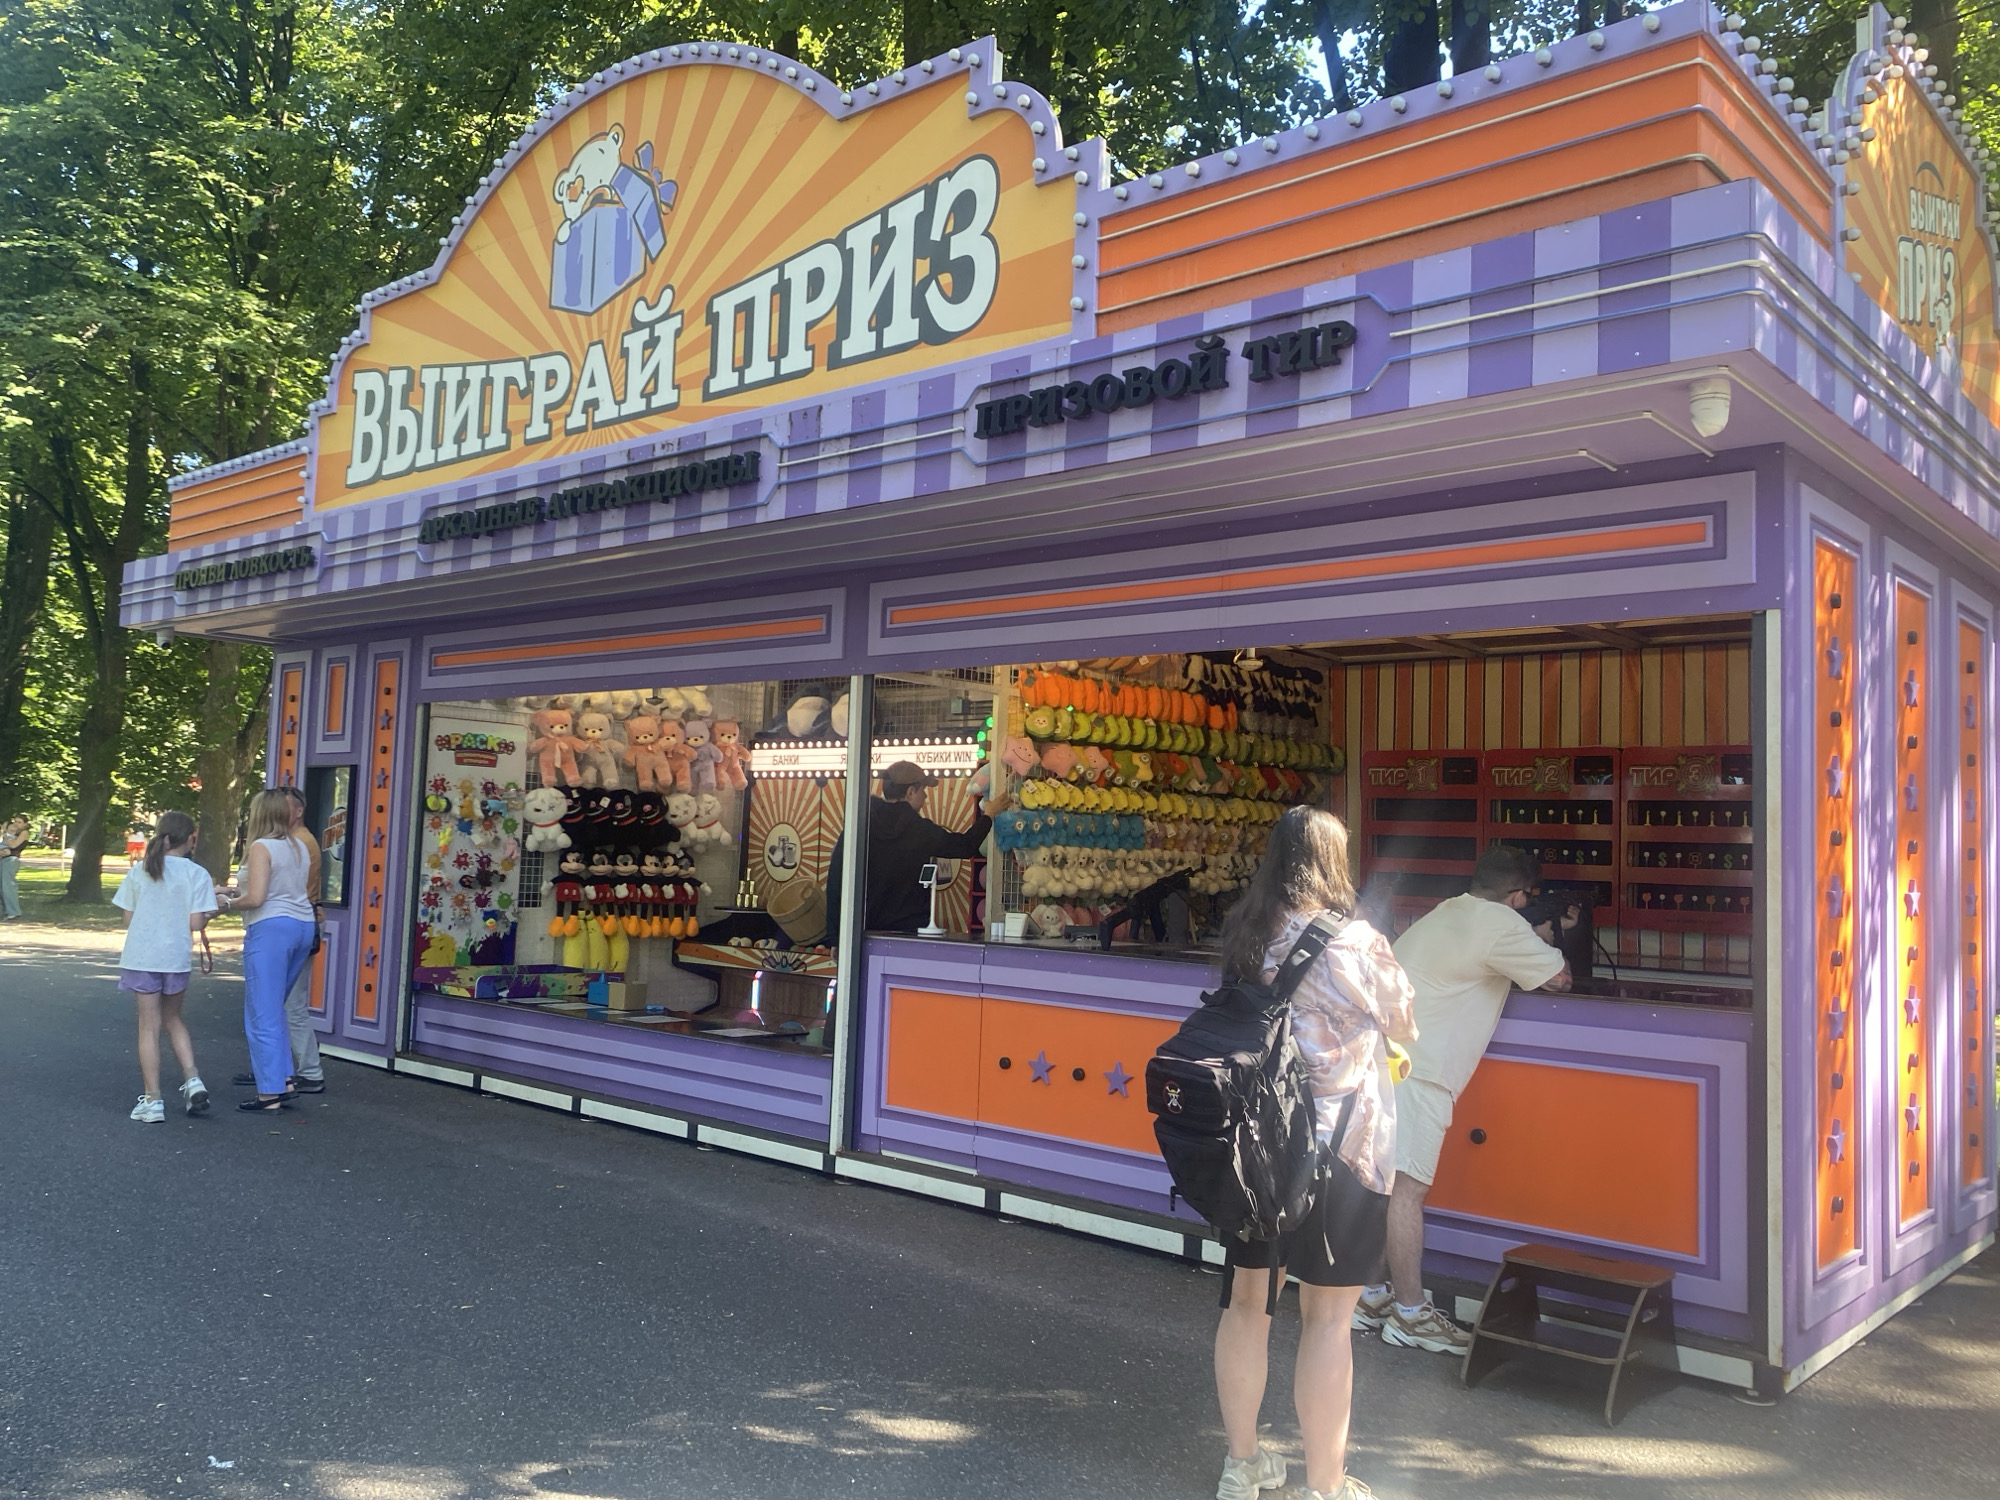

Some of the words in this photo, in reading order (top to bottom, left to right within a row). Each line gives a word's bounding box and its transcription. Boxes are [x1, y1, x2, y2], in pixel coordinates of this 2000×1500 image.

[1909, 187, 1960, 241] ВЫИГРАЙ
[1898, 236, 1955, 327] ПРИЗ
[345, 285, 684, 488] ВЫИГРАЙ
[702, 155, 1000, 402] ПРИЗ
[974, 336, 1230, 439] ПРИЗОВОЙ
[1242, 320, 1357, 382] ТИР
[418, 496, 546, 544] АРКАДНЫЕ
[545, 451, 761, 520] АТТРАКЦИОНЫ
[174, 562, 229, 591] ПРОЯВИ
[229, 546, 312, 581] ЛОВКОСТЬ
[772, 755, 799, 766] БАНКИ
[916, 752, 951, 763] КУБИКИ
[954, 751, 972, 762] WIN
[1368, 767, 1408, 786] ТИР
[1415, 767, 1427, 782] 1
[1492, 767, 1537, 787] ТИР
[1545, 766, 1559, 783] 2
[1629, 766, 1679, 787] ТИР
[1687, 766, 1702, 784] 3
